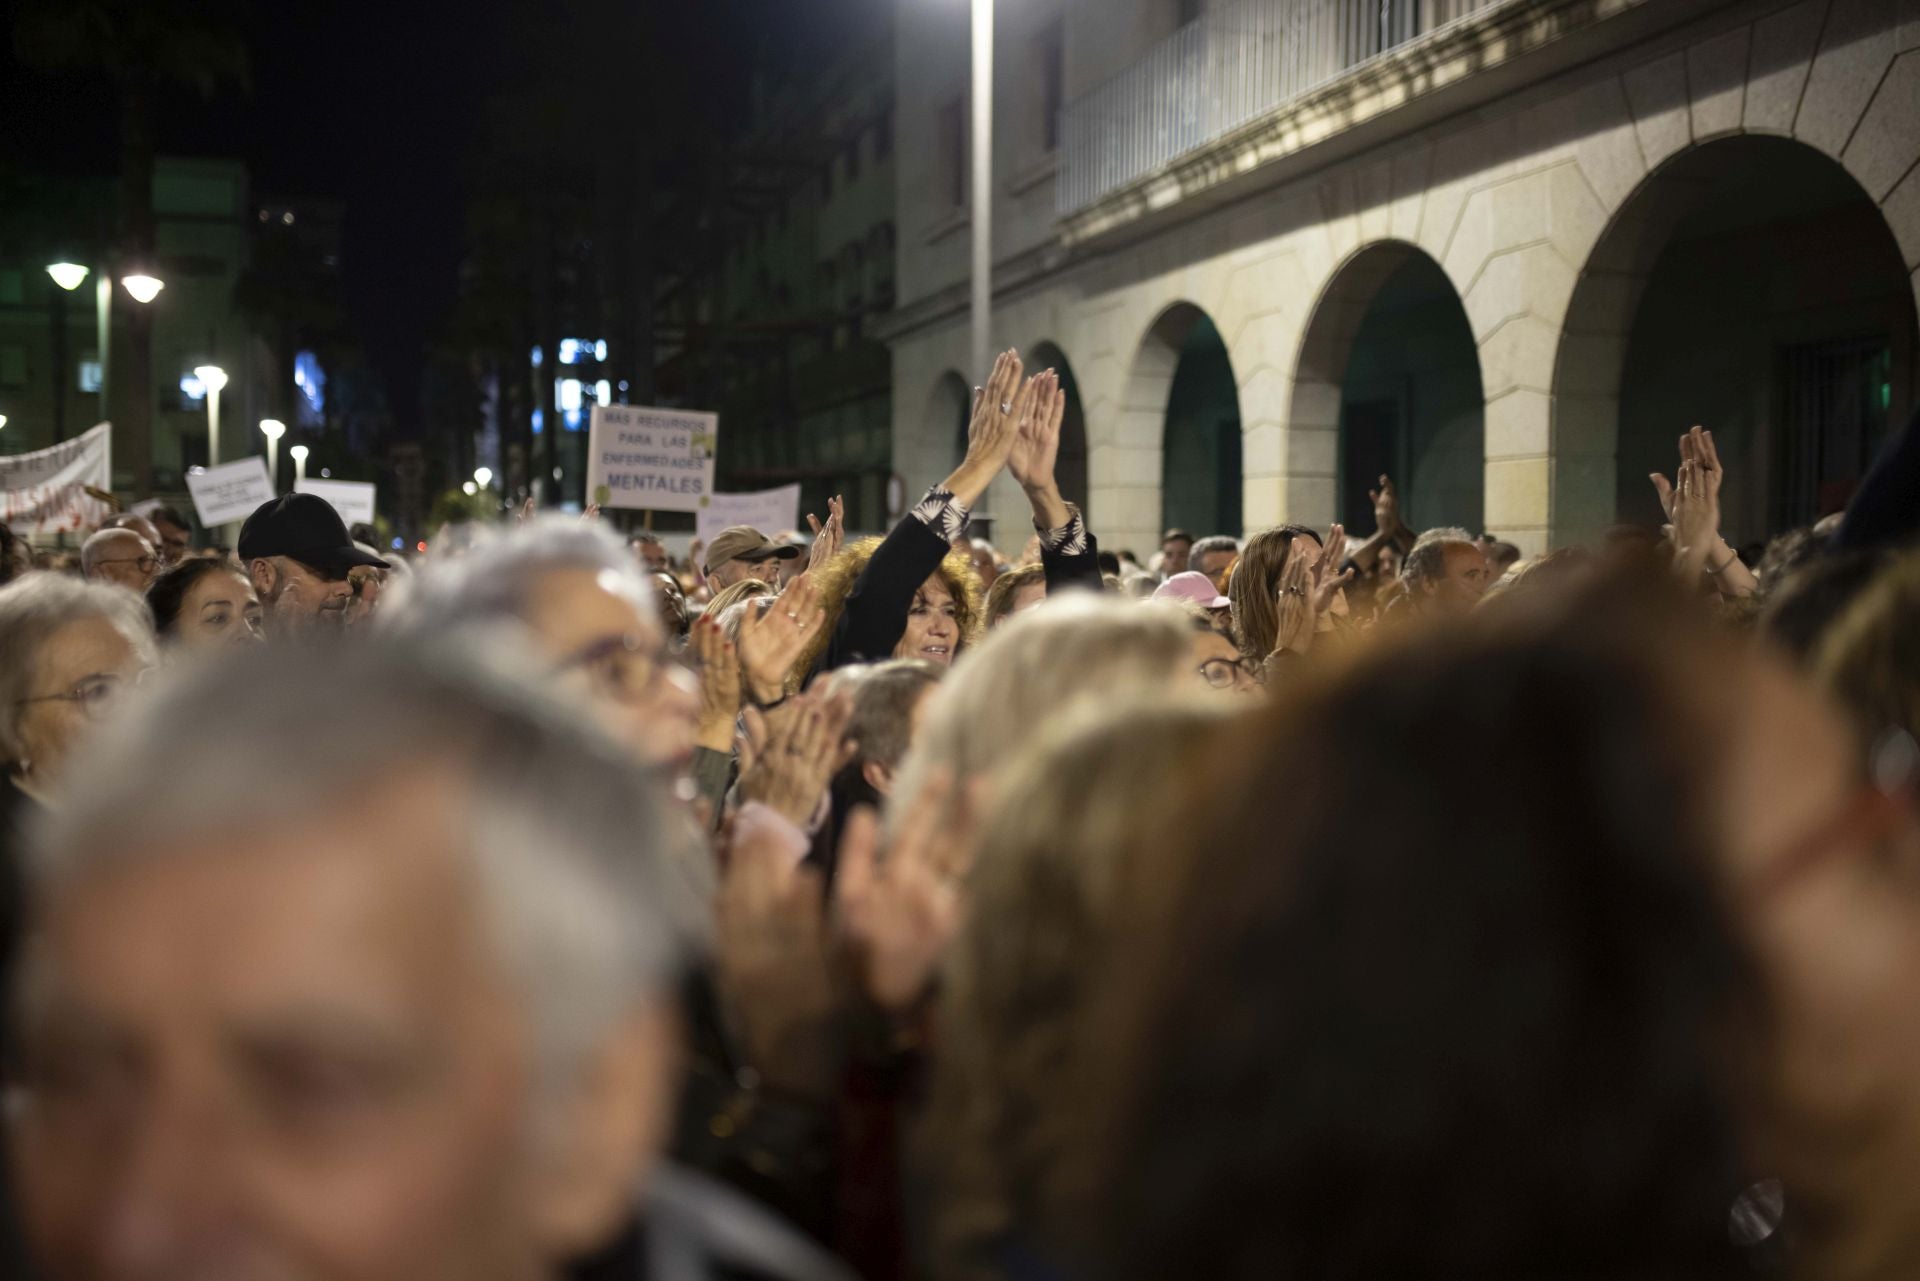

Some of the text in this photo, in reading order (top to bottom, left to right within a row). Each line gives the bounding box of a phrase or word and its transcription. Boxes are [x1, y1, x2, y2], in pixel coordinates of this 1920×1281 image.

[638, 416, 705, 431] RECURSOS
[618, 433, 688, 449] PARA LAS
[608, 473, 703, 493] MENTALES
